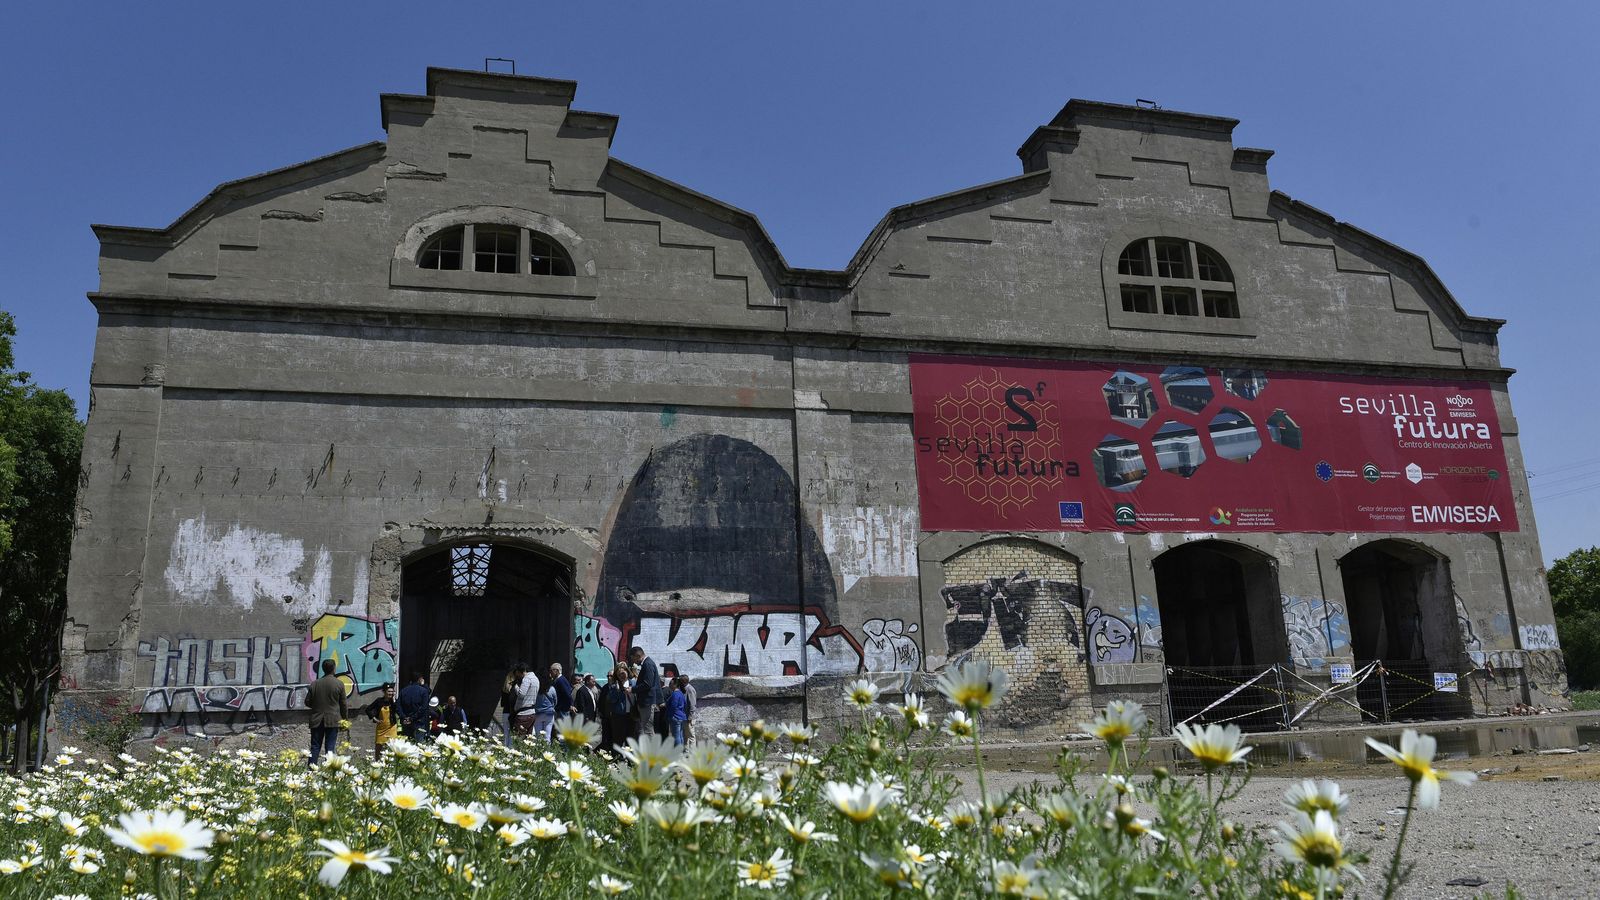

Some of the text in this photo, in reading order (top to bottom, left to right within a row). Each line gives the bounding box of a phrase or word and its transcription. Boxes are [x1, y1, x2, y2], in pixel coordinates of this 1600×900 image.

[1340, 393, 1436, 416] sevilla
[1393, 415, 1491, 439] futura
[918, 432, 1024, 454] sevilla
[1398, 439, 1493, 450] Centro de Innovación Abierta
[976, 453, 1080, 477] futura
[1440, 466, 1487, 474] HORIZONTE
[1411, 505, 1501, 523] EMVISESA
